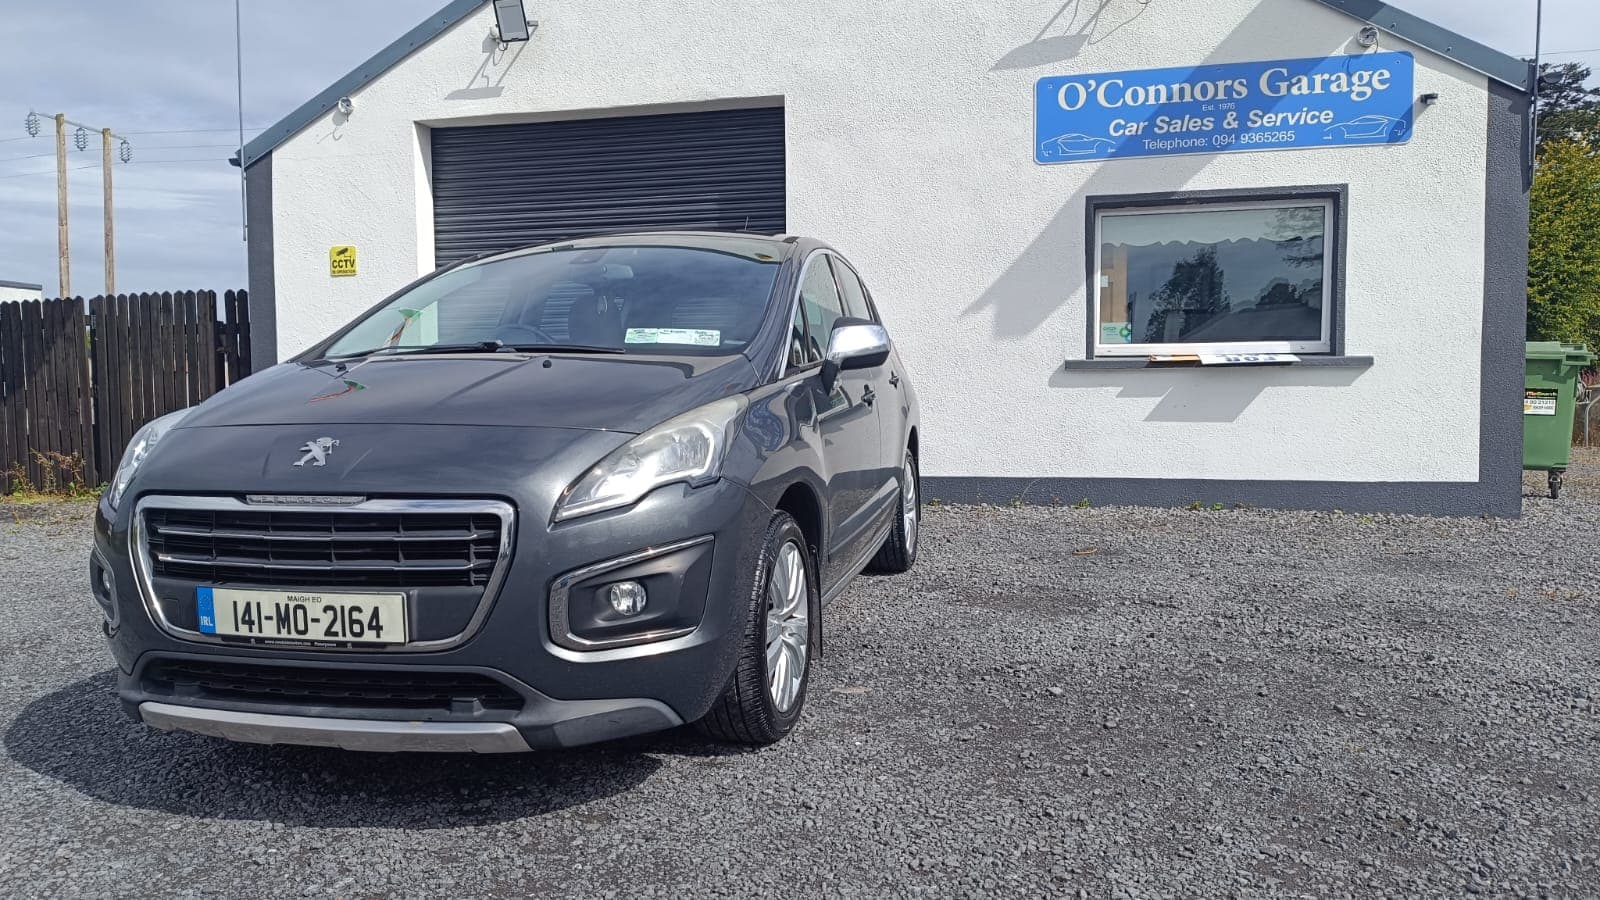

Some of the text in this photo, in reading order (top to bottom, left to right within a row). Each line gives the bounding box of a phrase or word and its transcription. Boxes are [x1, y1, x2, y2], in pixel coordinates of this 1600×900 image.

[1057, 67, 1391, 111] O'Connors Garage
[1108, 107, 1334, 137] Car Sales & Service
[1143, 131, 1295, 151] Telephone: 094 9365265
[332, 259, 355, 269] CCTV
[287, 595, 310, 603] MAIGH
[200, 615, 213, 627] IRL
[232, 600, 384, 639] 141-MO-2164
